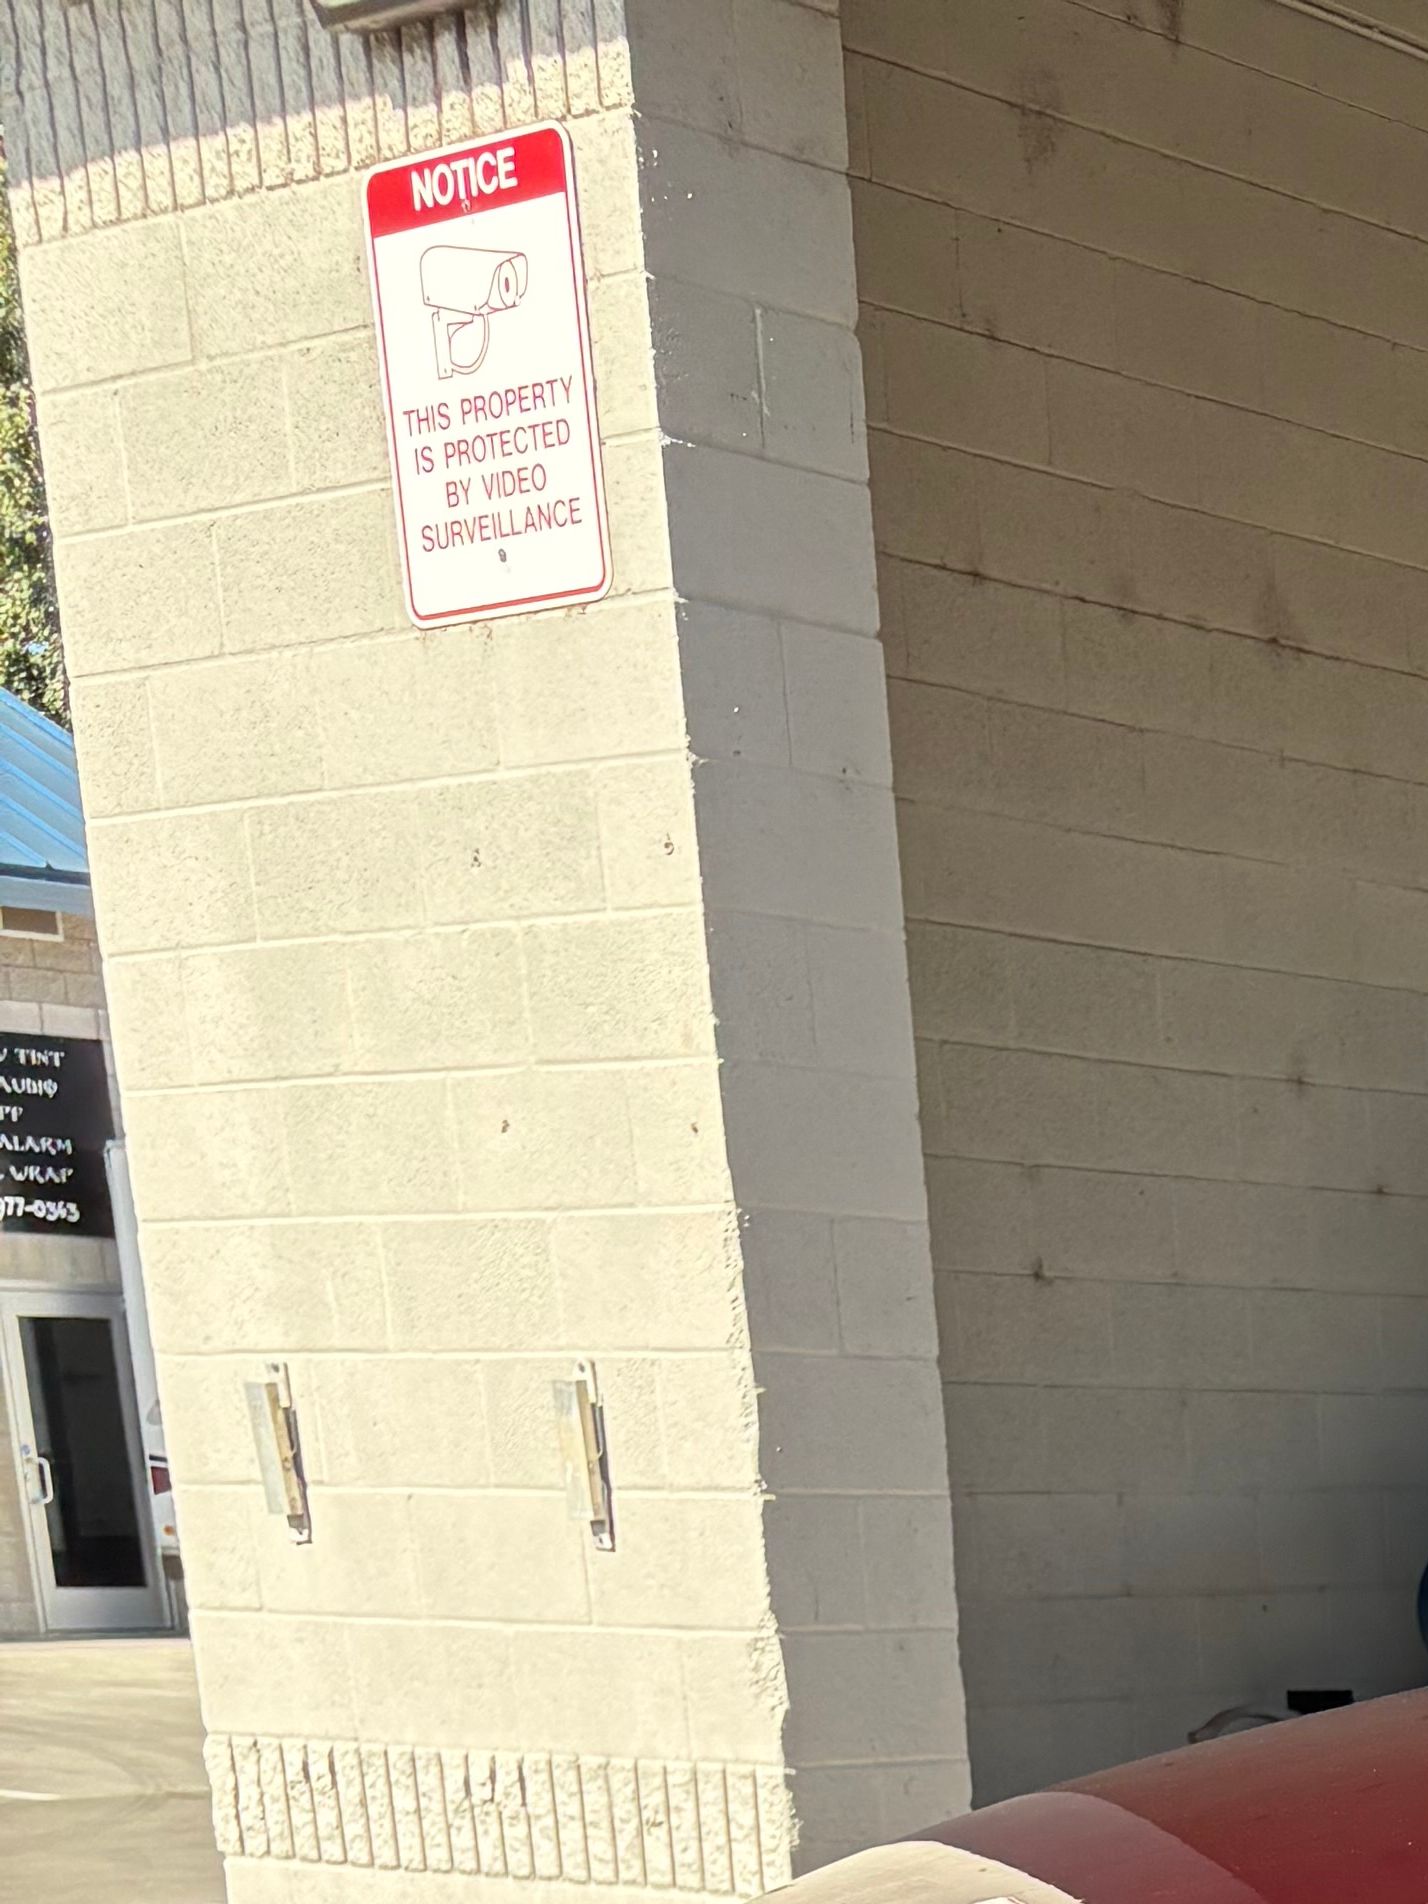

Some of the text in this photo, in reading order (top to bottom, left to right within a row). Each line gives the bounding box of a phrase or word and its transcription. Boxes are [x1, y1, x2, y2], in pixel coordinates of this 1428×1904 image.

[410, 146, 519, 212] NOTICE
[403, 375, 572, 437] THIS PROPERTY
[415, 418, 571, 475] IS PROTECTED
[446, 463, 547, 508] BY VIDEO
[421, 497, 583, 553] SURVEILLANCE
[14, 1048, 65, 1067] TINT
[0, 1133, 72, 1155] ALARM
[9, 1165, 73, 1184] WRAP
